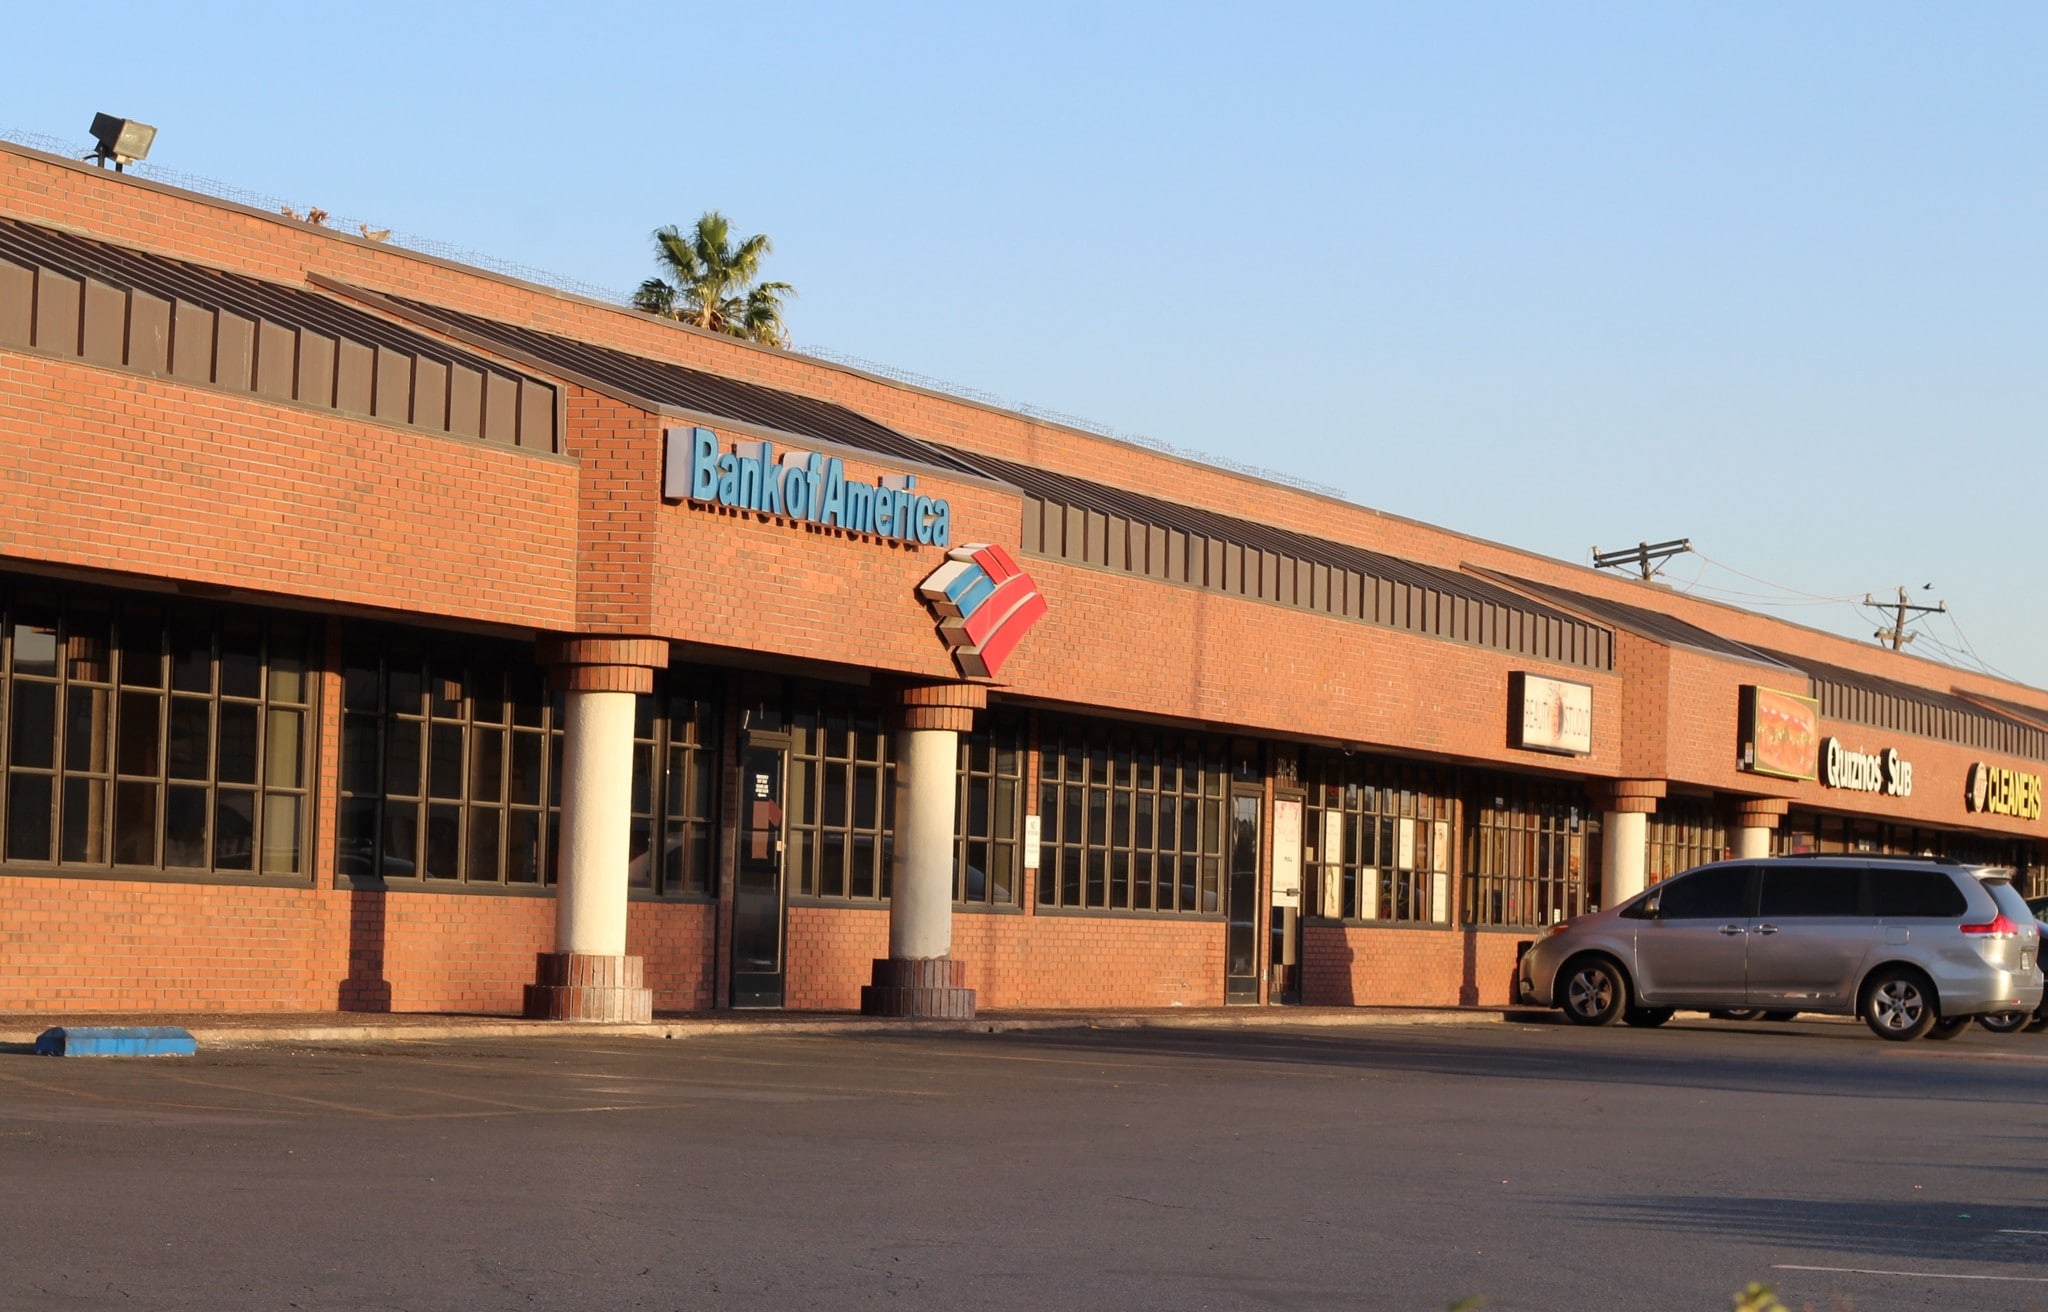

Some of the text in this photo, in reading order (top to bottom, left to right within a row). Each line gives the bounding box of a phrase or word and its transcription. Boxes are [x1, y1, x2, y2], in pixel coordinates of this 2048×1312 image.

[692, 427, 950, 548] Bank of America
[1988, 766, 2042, 821] CLEANERS
